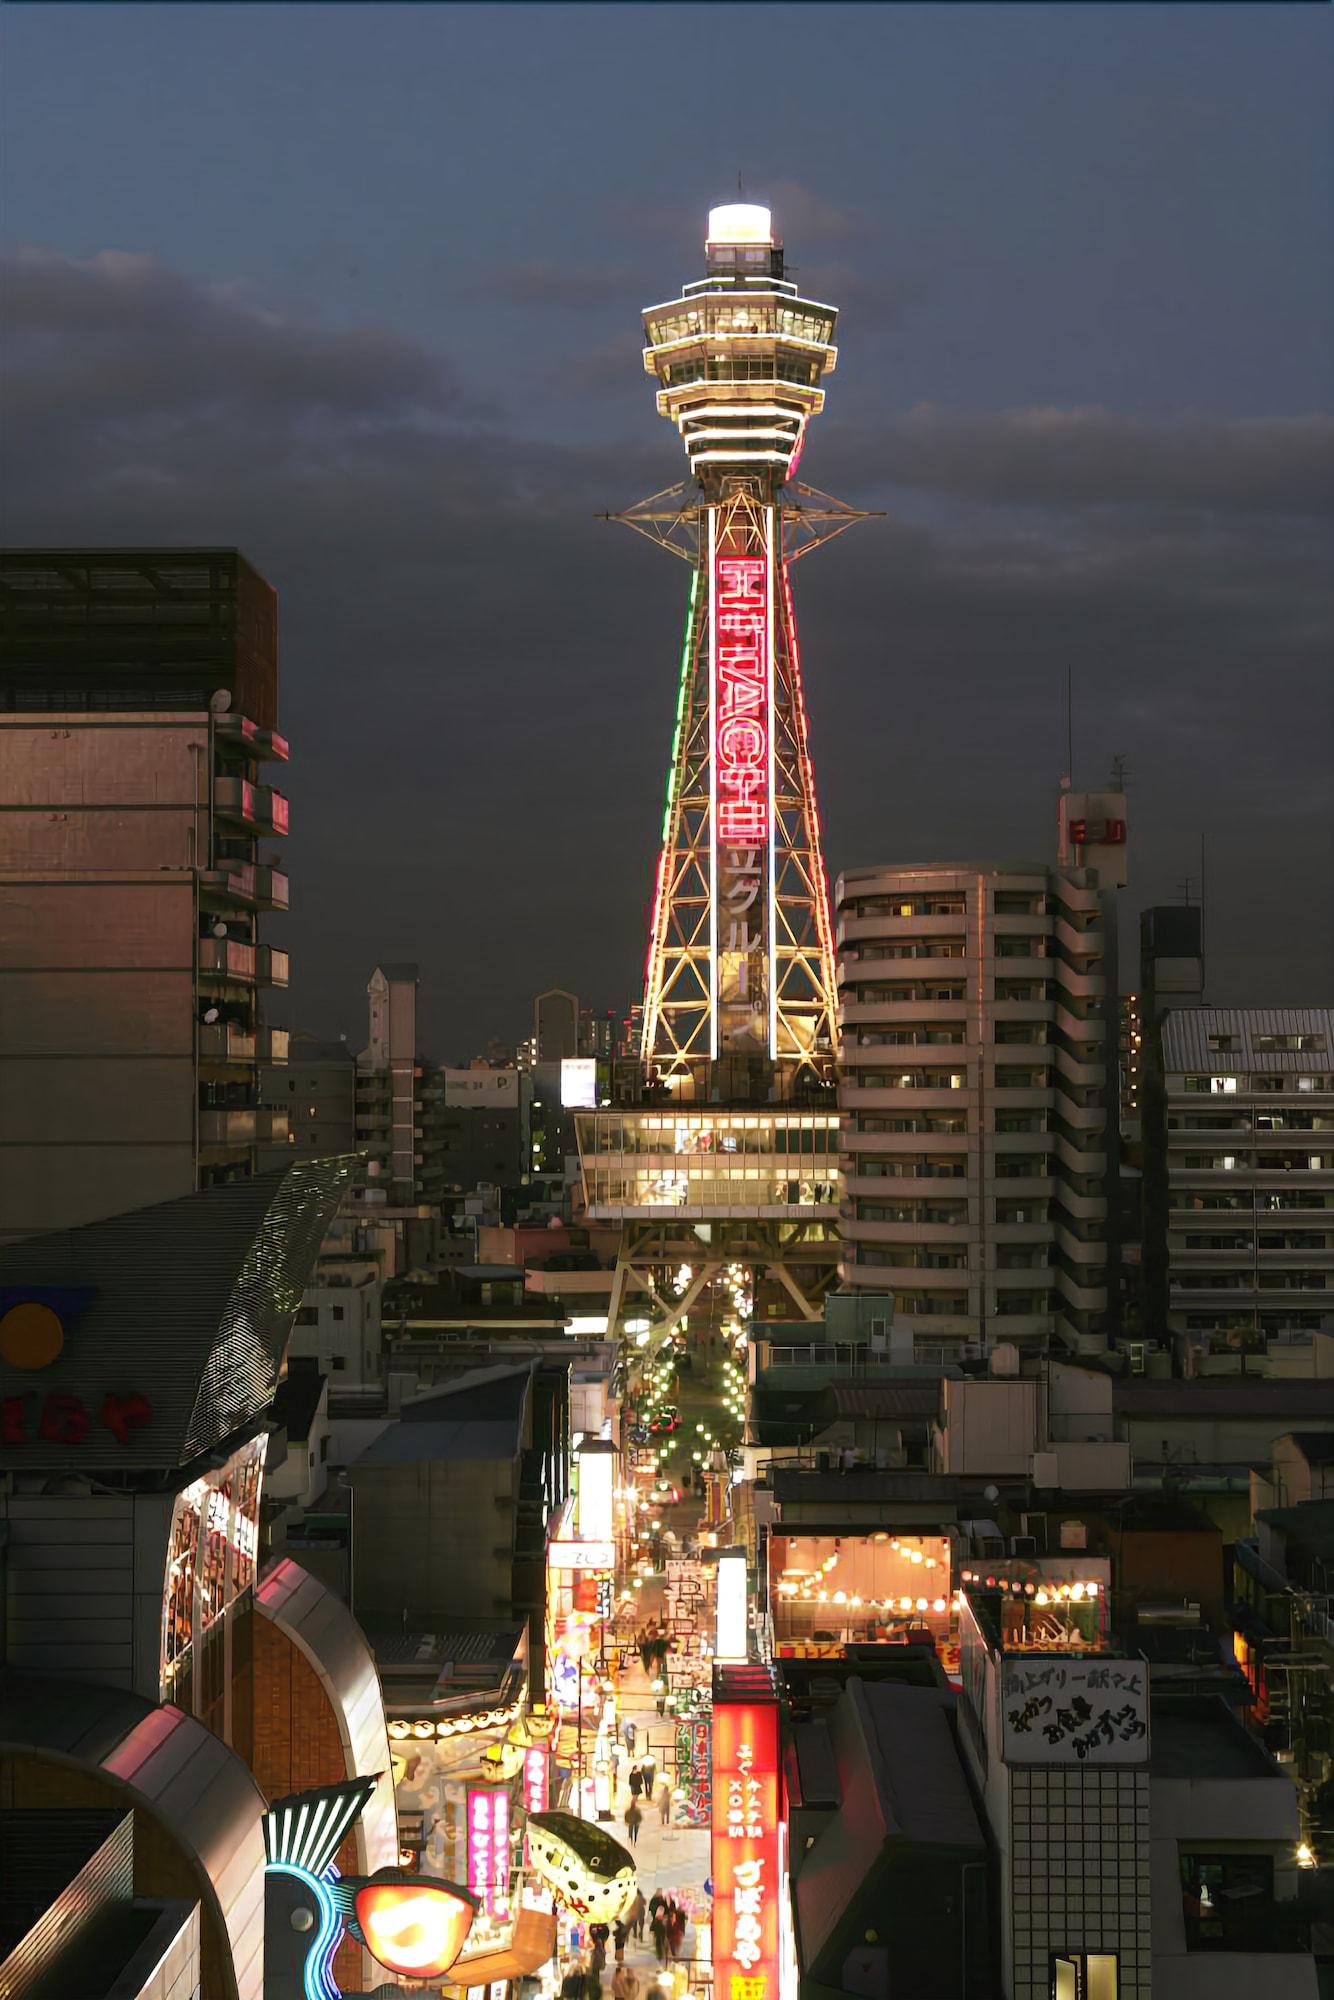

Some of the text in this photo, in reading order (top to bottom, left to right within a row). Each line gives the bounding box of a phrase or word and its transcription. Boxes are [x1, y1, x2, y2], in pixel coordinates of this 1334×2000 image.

[719, 559, 765, 839] HITACHI
[723, 844, 763, 1035] 立グループ
